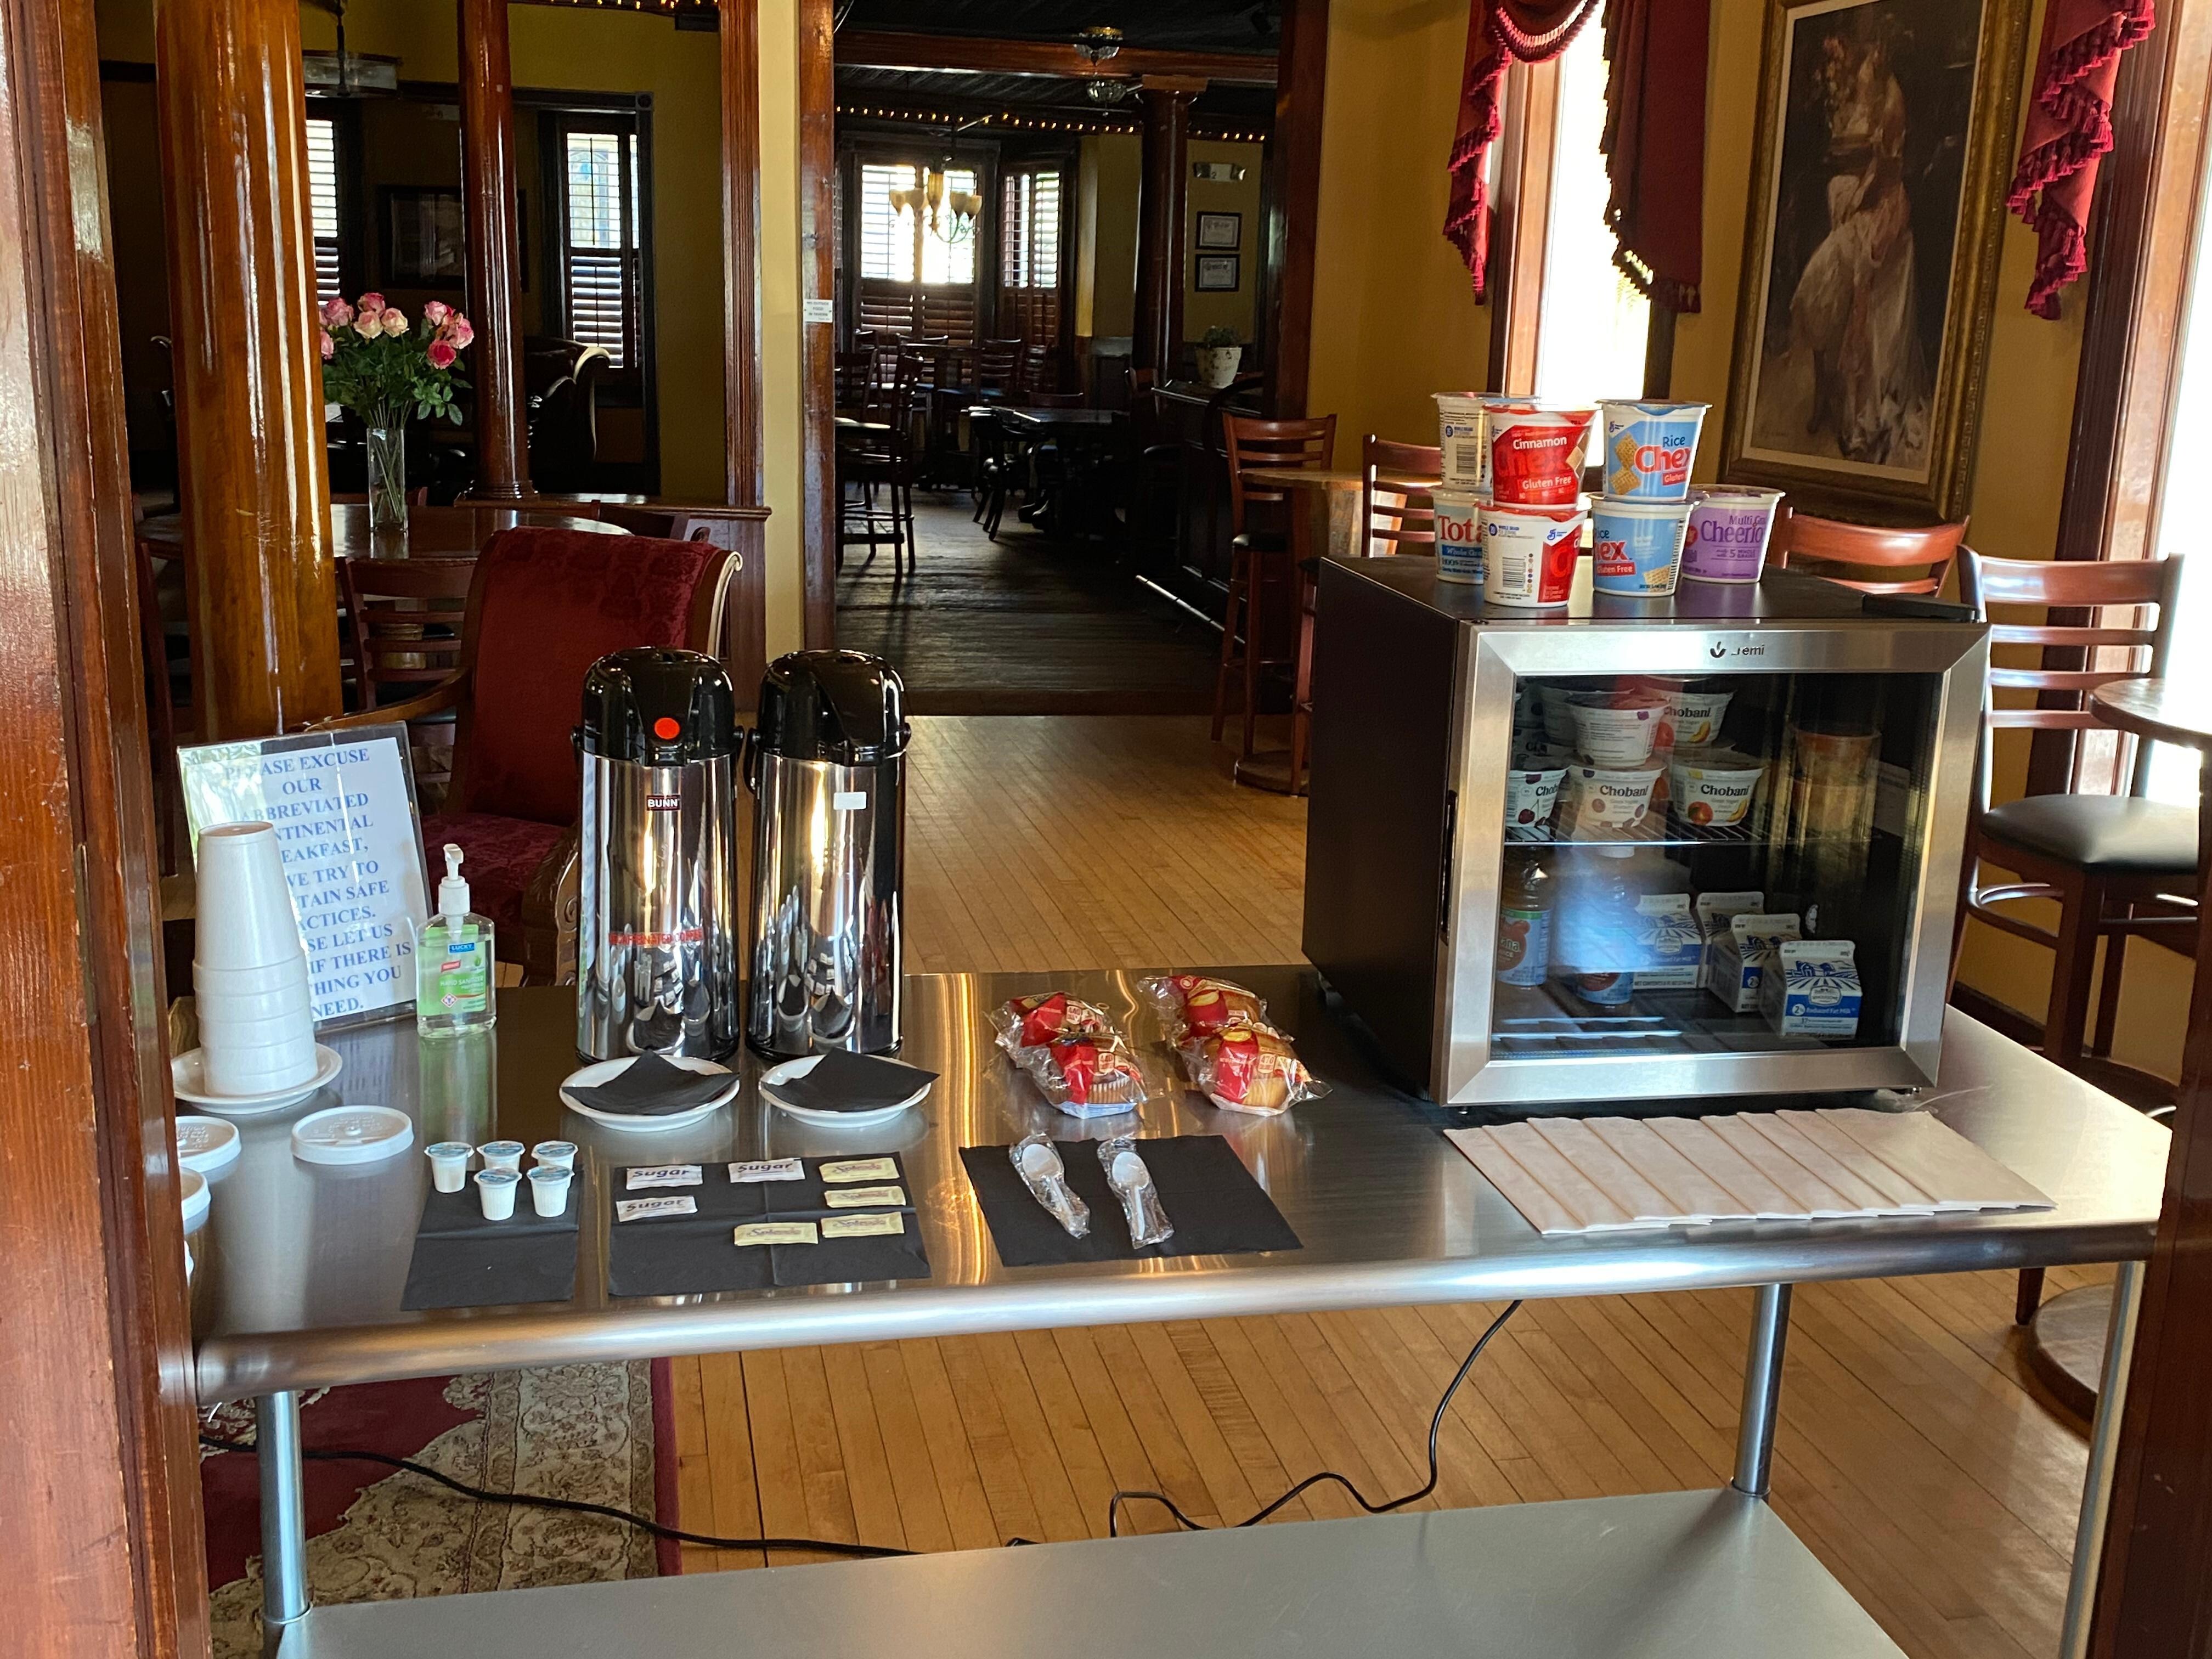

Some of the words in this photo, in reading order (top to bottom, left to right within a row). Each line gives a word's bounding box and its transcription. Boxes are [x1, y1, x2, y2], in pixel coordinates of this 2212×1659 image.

[1513, 436, 1567, 450] Cinnamon
[1662, 435, 1686, 447] Rice
[1522, 478, 1553, 489] Gluten
[1555, 476, 1572, 486] Free
[1664, 474, 1685, 483] Gluten
[1437, 515, 1482, 543] Tot
[1729, 515, 1752, 526] Multi
[1701, 520, 1764, 543] Cheerio
[1595, 541, 1628, 561] ex
[1663, 706, 1712, 718] Chobani
[225, 759, 295, 780] PASE
[299, 748, 370, 770] EXCUSE
[283, 778, 322, 795] OUR
[1536, 783, 1559, 796] Chob
[1600, 785, 1649, 797] Chobani
[1701, 784, 1750, 796] Chobani
[242, 793, 369, 821] ABBREVIATED
[647, 799, 678, 808] BUNN
[275, 815, 374, 842] NTINENTAL
[281, 838, 369, 864] EAKFAST,
[313, 865, 349, 883] TRY
[356, 860, 379, 876] TO
[297, 889, 341, 909] TAIN
[346, 880, 390, 900] SAFE
[299, 906, 376, 931] CTICES.
[333, 928, 368, 947] LET
[371, 923, 393, 939] US
[311, 958, 326, 974] IF
[331, 946, 391, 969] THERE
[396, 941, 411, 956] IS
[314, 974, 359, 996] HING
[364, 965, 402, 985] YOU
[311, 997, 364, 1018] NEED.
[1262, 1055, 1274, 1064] 470
[738, 1163, 793, 1173] Sugar
[627, 1199, 685, 1212] Sugar
